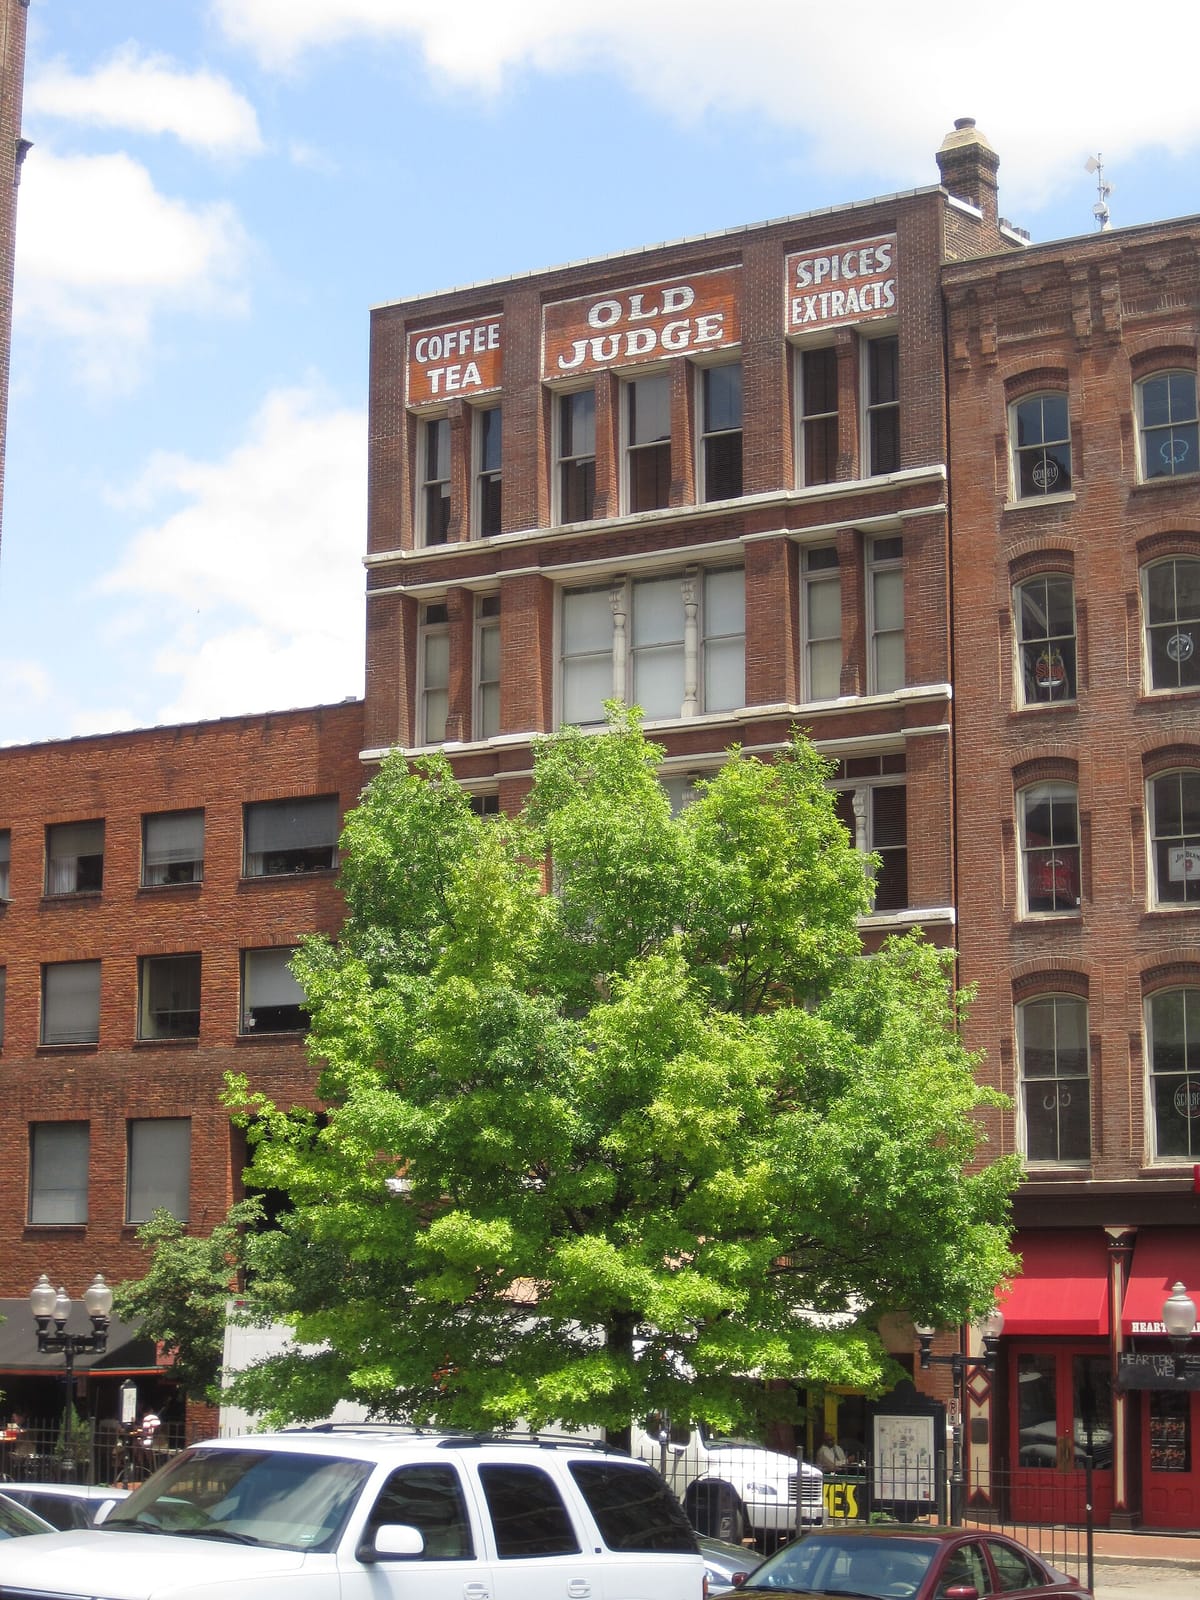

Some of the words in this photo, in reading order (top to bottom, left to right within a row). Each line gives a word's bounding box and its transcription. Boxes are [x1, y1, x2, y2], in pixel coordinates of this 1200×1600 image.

[796, 243, 892, 288] SPICES
[588, 286, 695, 329] OLD
[792, 279, 896, 325] EXTRACTS
[415, 323, 500, 363] COFFEE
[557, 313, 724, 369] JUDGE
[426, 361, 482, 394] TEA
